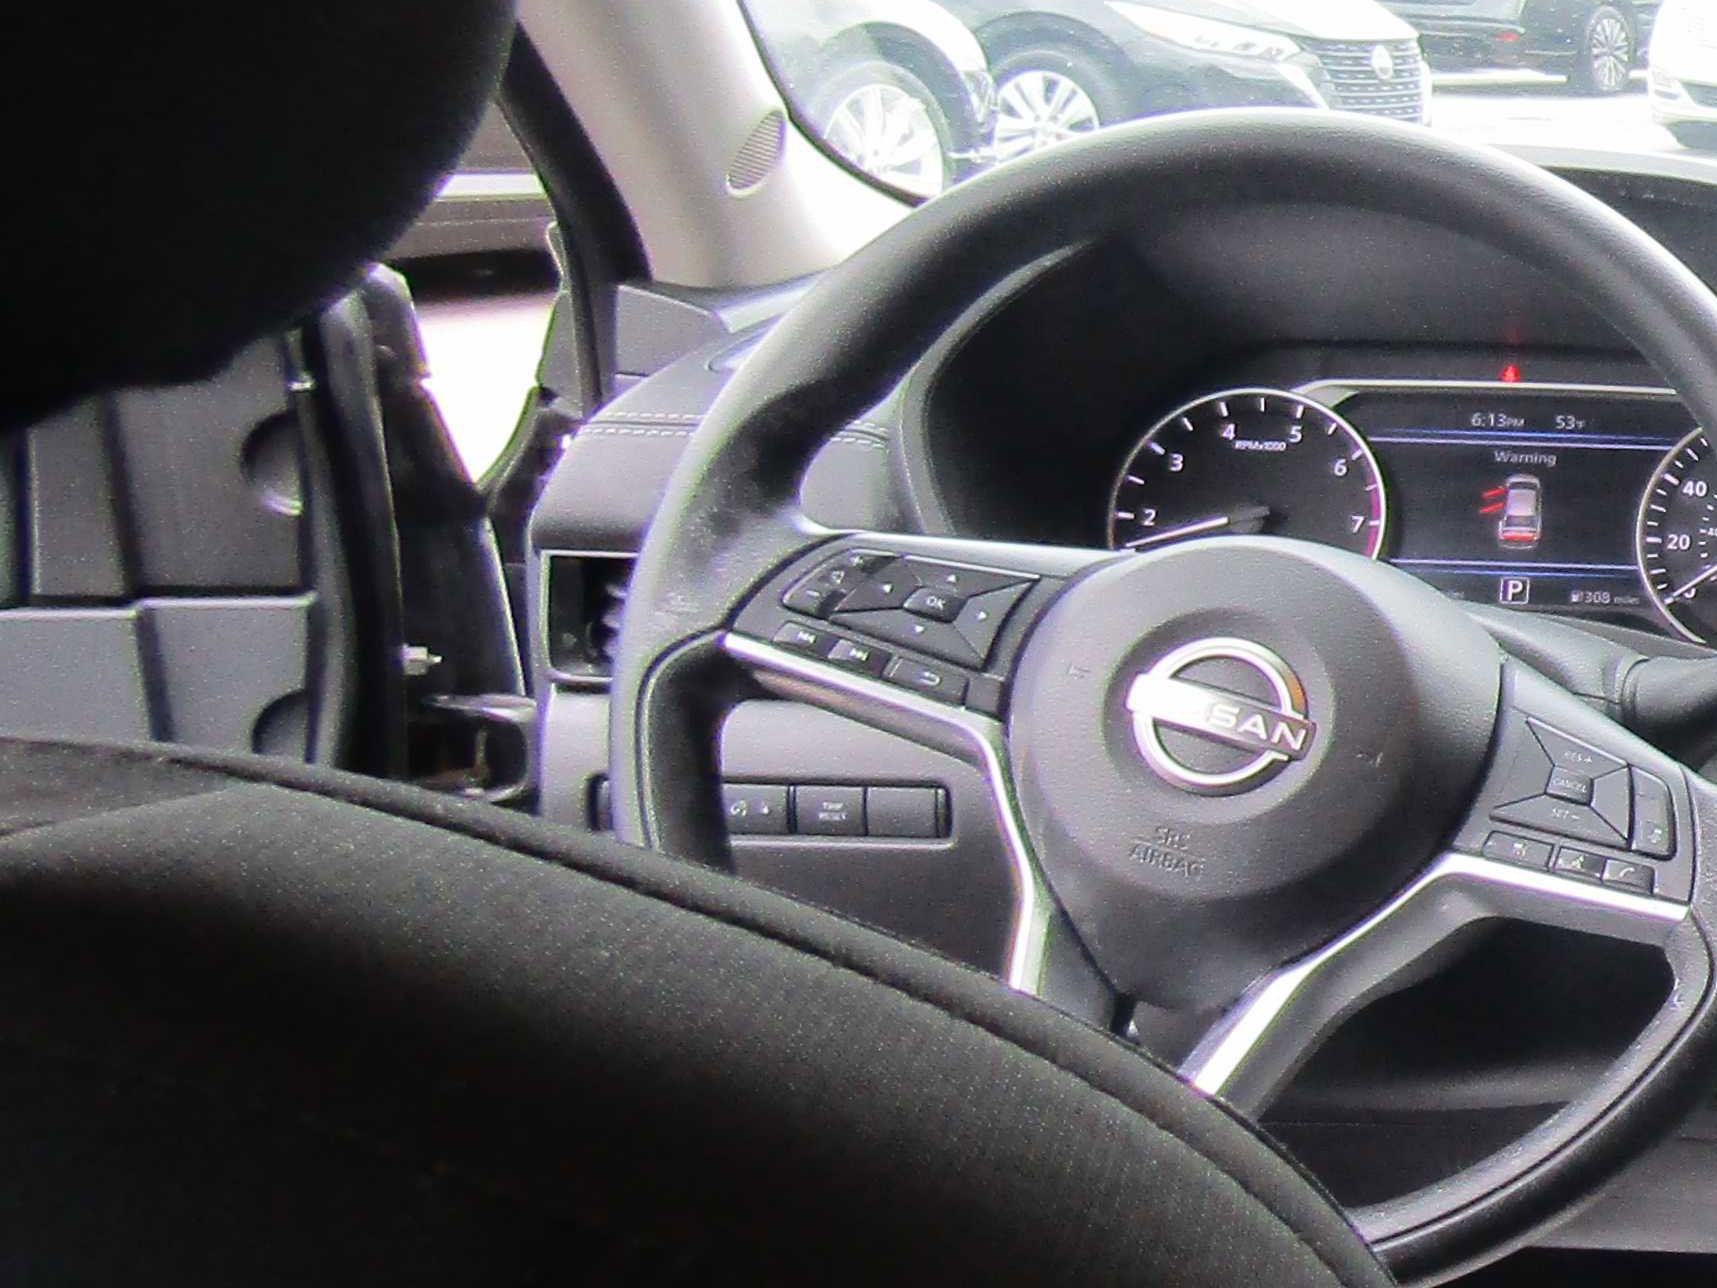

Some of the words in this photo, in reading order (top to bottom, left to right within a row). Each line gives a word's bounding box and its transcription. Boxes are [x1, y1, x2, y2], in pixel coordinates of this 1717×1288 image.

[1222, 423, 1236, 441] 4
[1289, 425, 1303, 444] 5
[1169, 453, 1184, 472] 3
[1333, 458, 1348, 477] 6
[1493, 450, 1558, 468] Warning
[1682, 480, 1708, 497] 40
[1142, 507, 1157, 527] 2
[1350, 515, 1365, 534] 7
[1666, 534, 1691, 551] 20
[1507, 579, 1524, 602] P
[926, 595, 946, 611] OK
